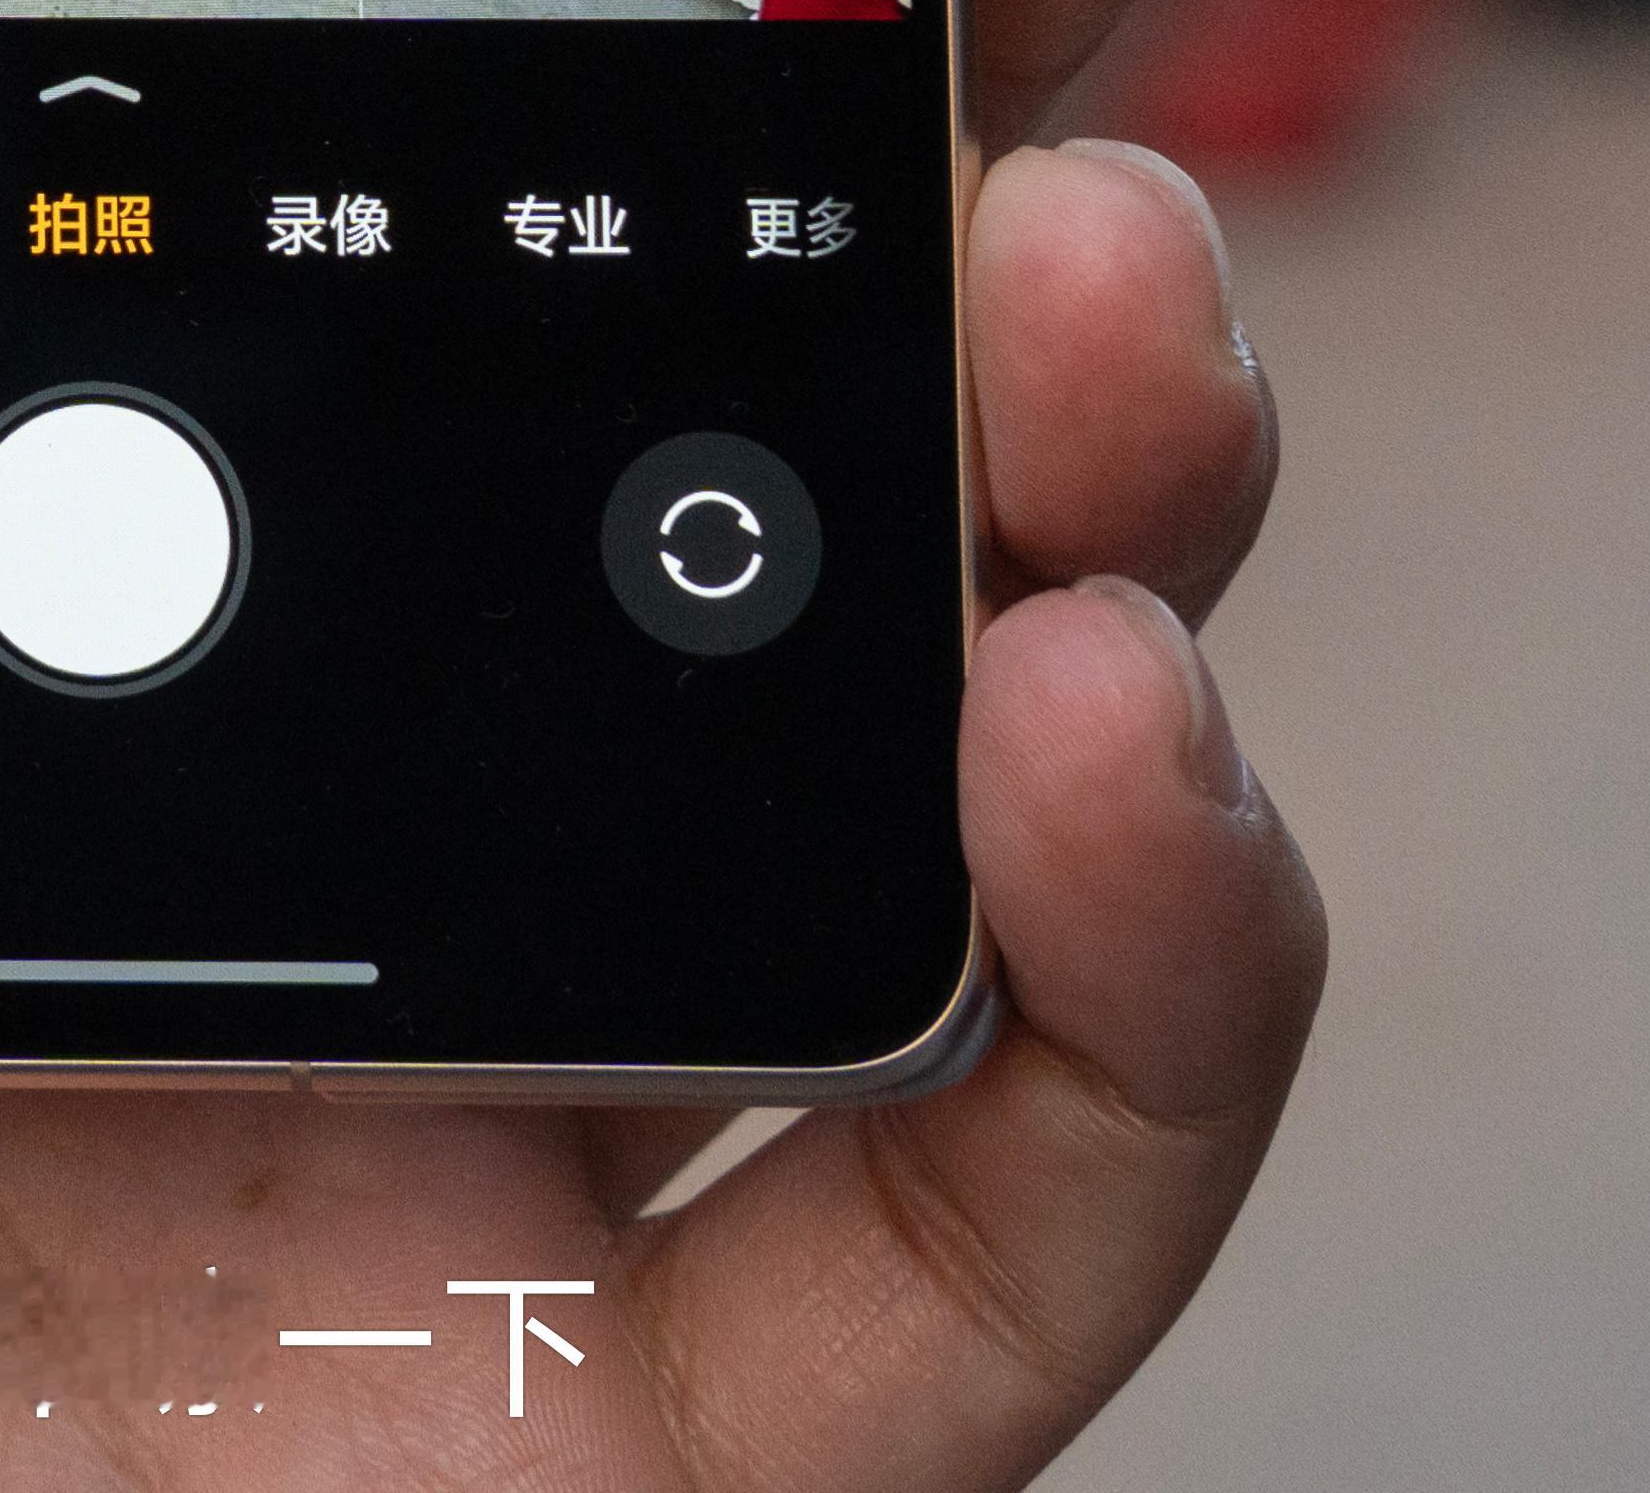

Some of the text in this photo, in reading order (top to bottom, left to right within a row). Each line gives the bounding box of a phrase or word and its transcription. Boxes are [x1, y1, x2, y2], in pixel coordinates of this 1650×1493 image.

[27, 191, 155, 257] 拍照
[265, 192, 393, 258] 录像
[502, 192, 632, 259] 专业
[745, 194, 858, 260] 更多
